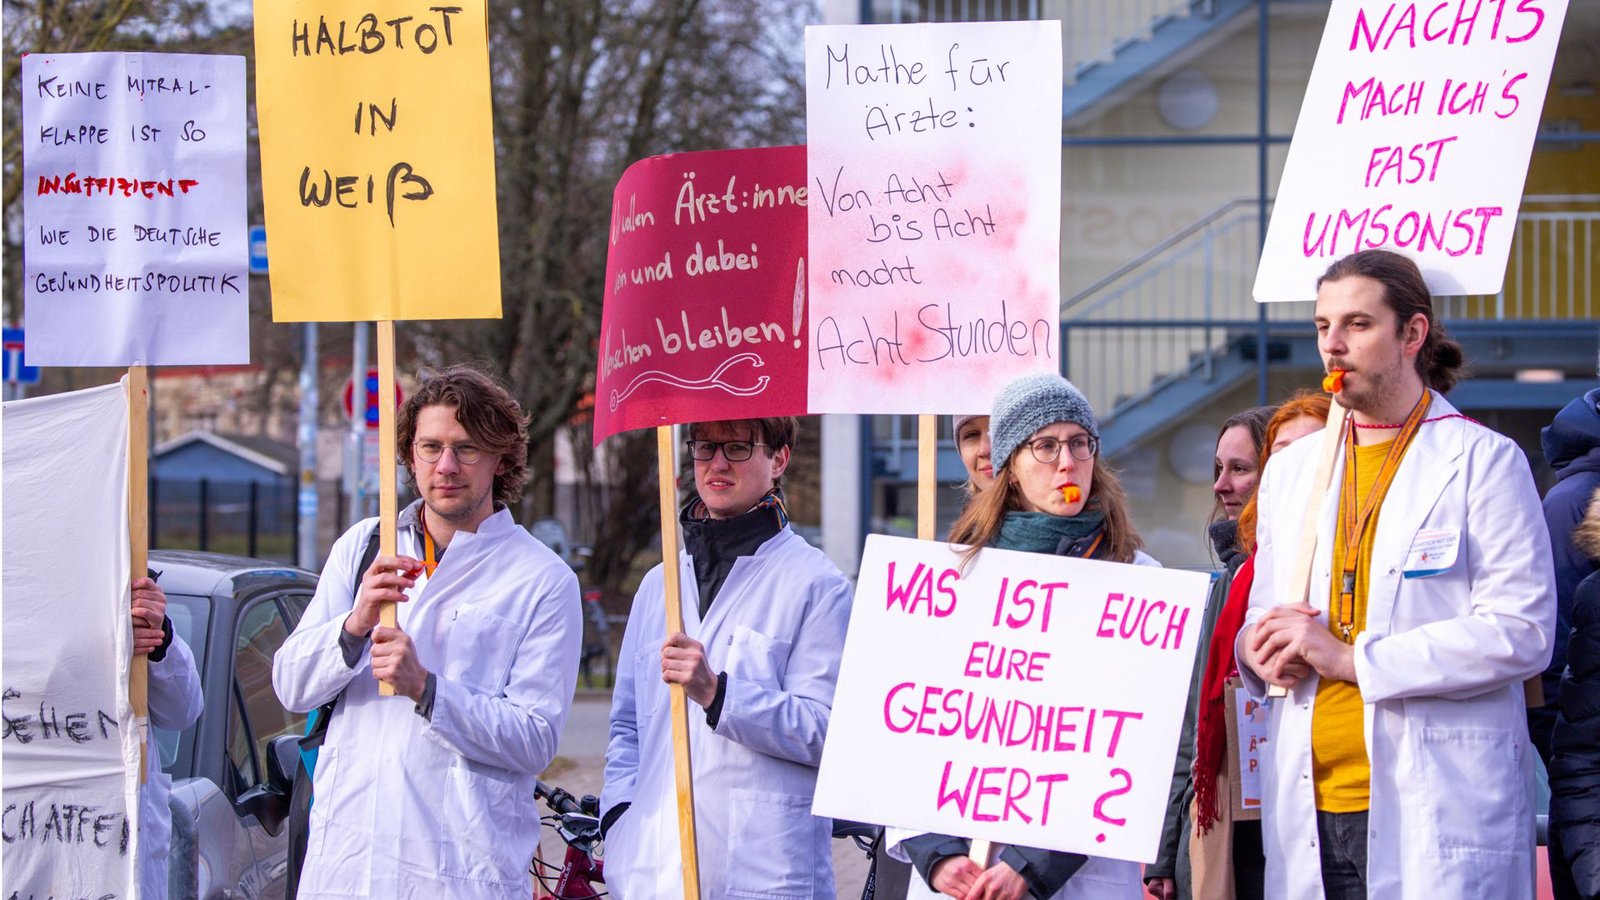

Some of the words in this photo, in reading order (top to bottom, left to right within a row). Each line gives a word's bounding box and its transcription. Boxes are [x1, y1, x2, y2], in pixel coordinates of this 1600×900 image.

[292, 6, 463, 57] HALBTOT
[1349, 0, 1545, 53] NACHTS
[38, 74, 108, 99] KEINE
[128, 75, 212, 96] MITRAL-
[826, 43, 927, 89] Mathe
[945, 43, 1010, 91] für
[354, 97, 397, 137] IN
[865, 98, 976, 140] Ärzte:
[1336, 76, 1425, 124] MACH
[40, 125, 109, 145] KLAPPE
[132, 125, 162, 143] IST
[181, 120, 206, 142] SO
[1365, 136, 1458, 187] FAST
[38, 173, 200, 199] INSUFFIZIENT
[675, 171, 808, 225] Ärzt:inne
[816, 166, 872, 217] Von
[884, 172, 953, 204] Acht
[40, 225, 70, 245] WIE
[88, 226, 117, 242] DIE
[134, 224, 221, 247] DEUTSCHE
[867, 214, 923, 242] bis
[934, 205, 997, 240] Acht
[1302, 204, 1503, 258] UMSONST
[35, 272, 240, 294] GESUNDHEITSPOLITIK
[631, 251, 673, 284] und
[686, 239, 758, 276] dabei
[831, 256, 923, 288] macht
[817, 311, 911, 370] Acht
[917, 300, 1052, 363] Stunden
[886, 561, 962, 618] WAS
[992, 577, 1069, 633] IST
[1096, 593, 1190, 650] EUCH
[964, 641, 1051, 682] EURE
[883, 682, 1144, 758] GESUNDHEIT
[937, 761, 1069, 826] WERT
